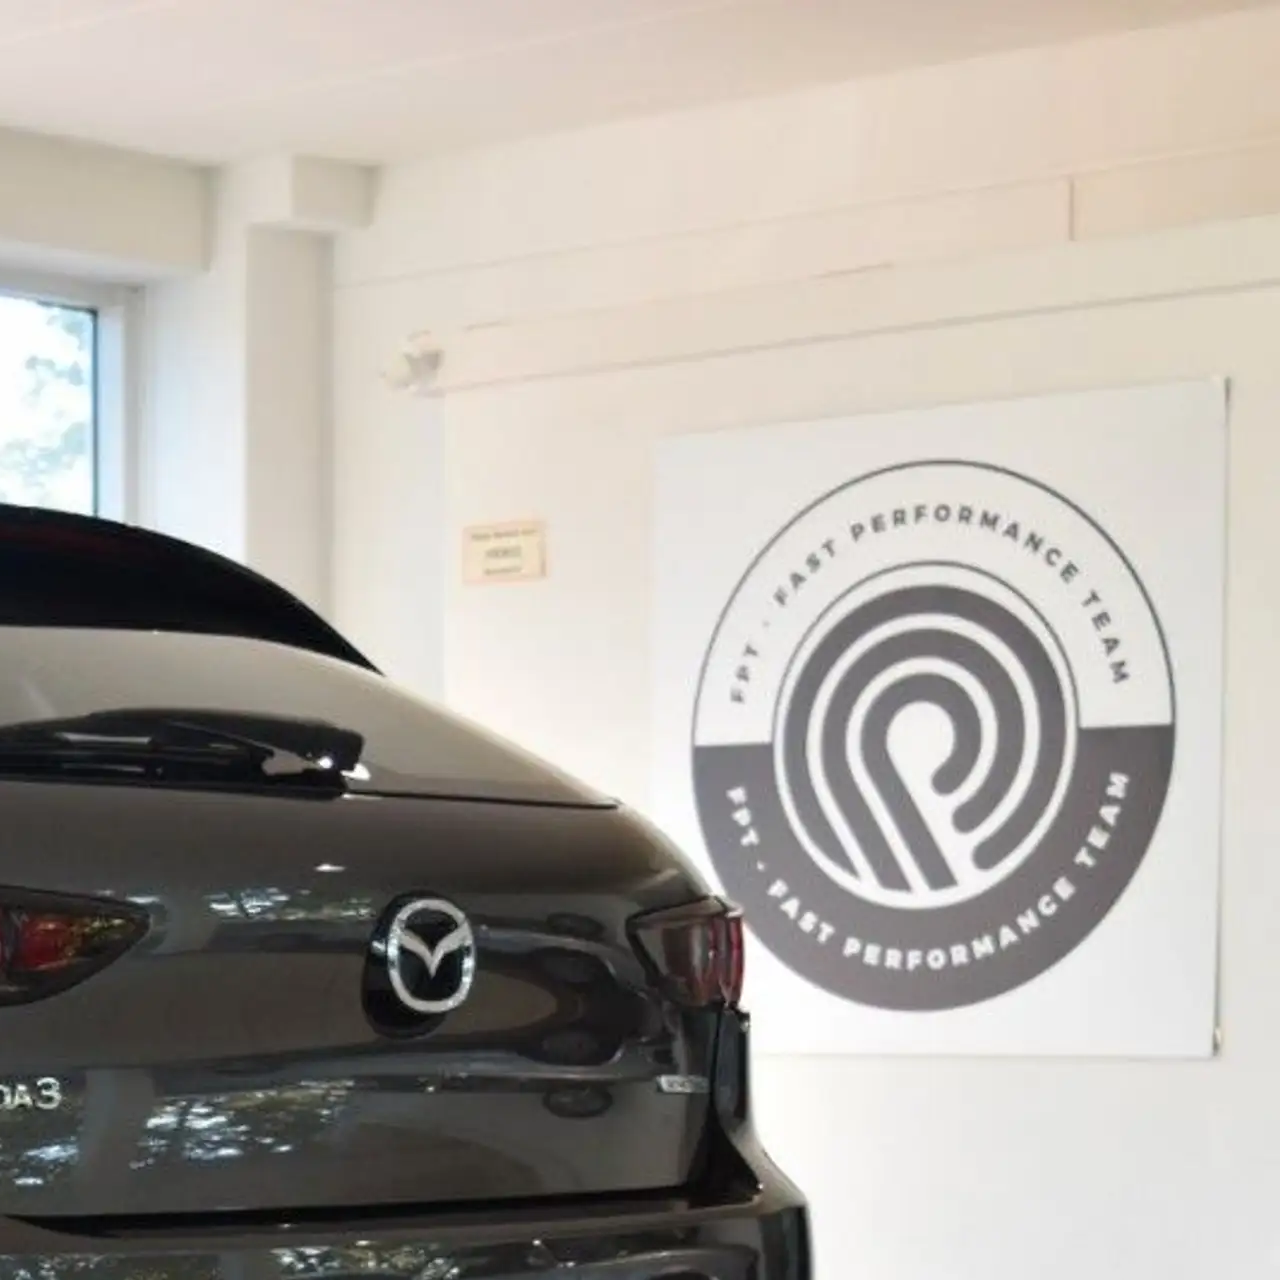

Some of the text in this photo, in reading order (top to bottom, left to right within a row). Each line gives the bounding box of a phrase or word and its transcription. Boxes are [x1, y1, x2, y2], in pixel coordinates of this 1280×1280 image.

[730, 503, 1132, 704] FPT FAST PERFORMANCE TEAM
[726, 772, 1130, 971] FPT FAST PERFORMANCE TEAM
